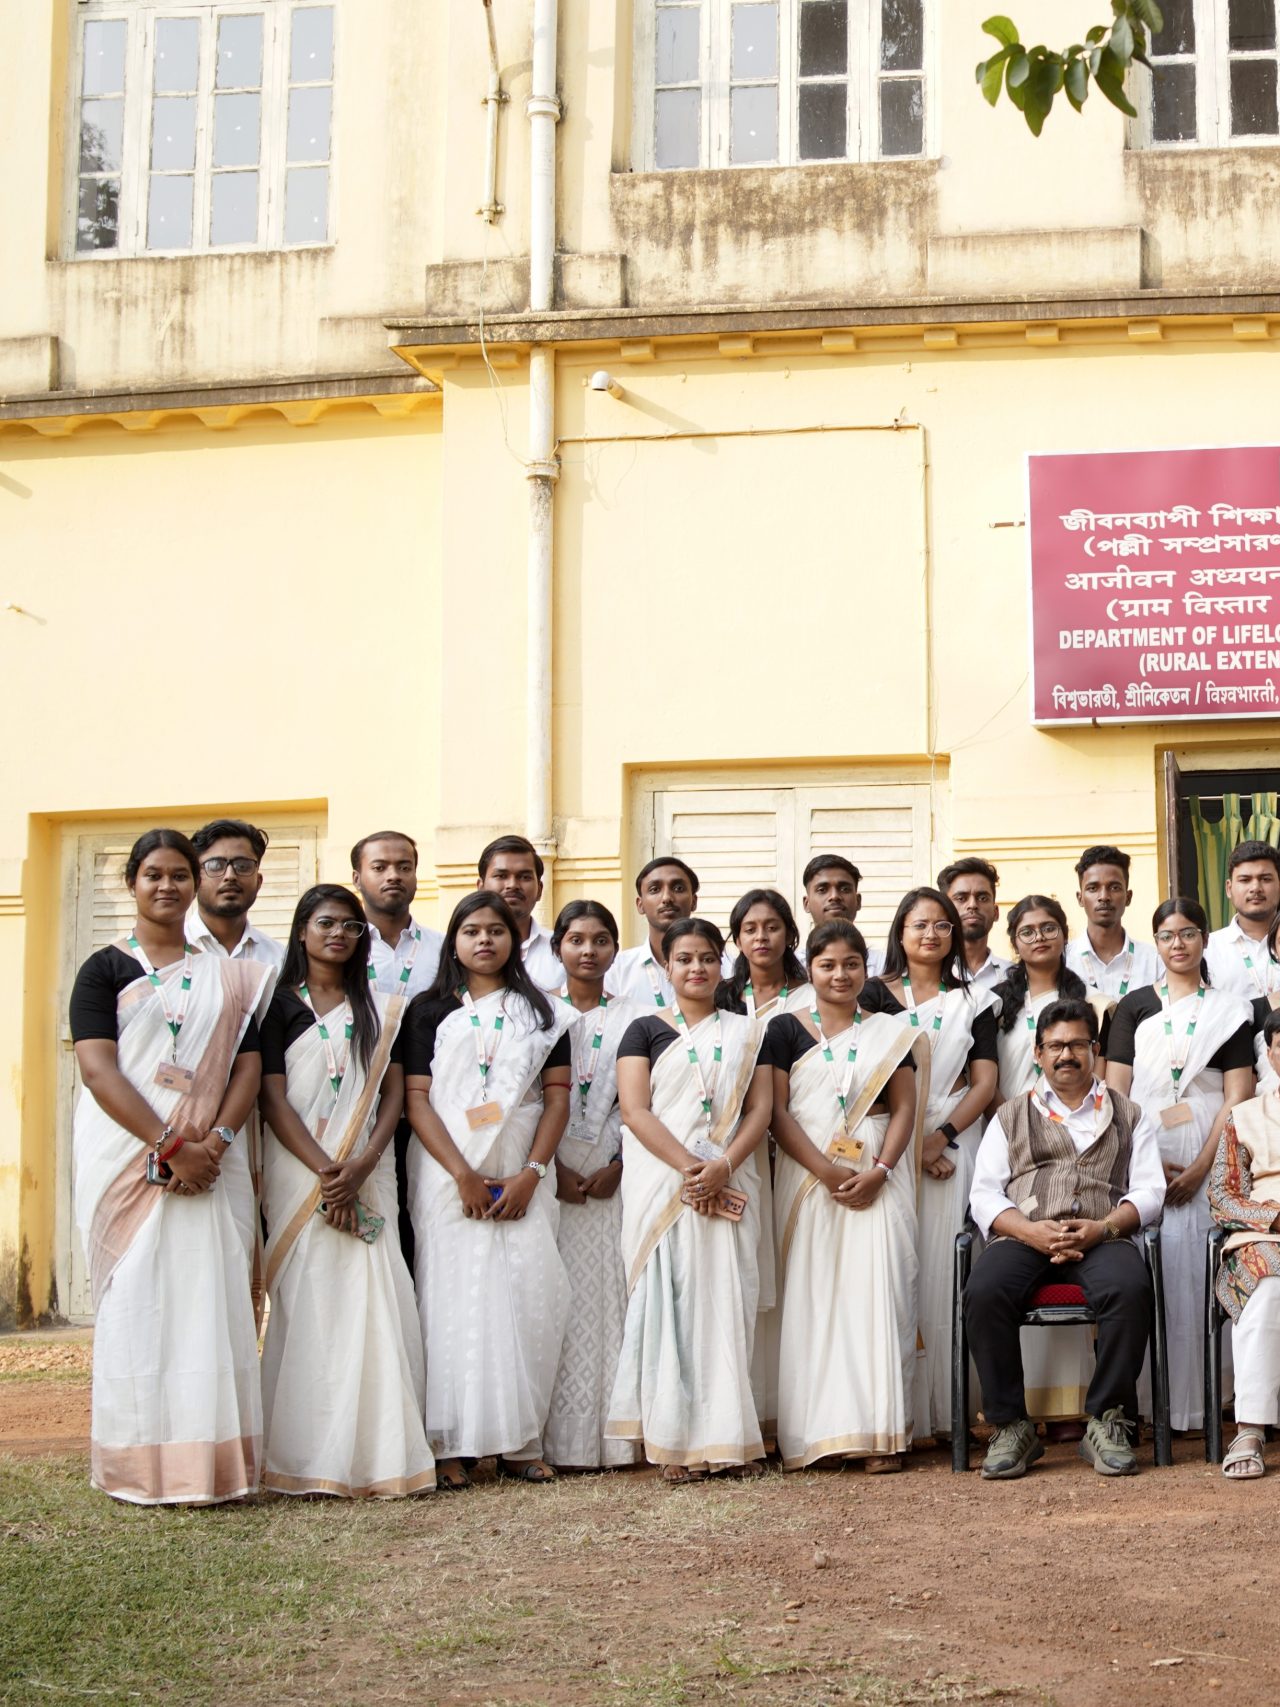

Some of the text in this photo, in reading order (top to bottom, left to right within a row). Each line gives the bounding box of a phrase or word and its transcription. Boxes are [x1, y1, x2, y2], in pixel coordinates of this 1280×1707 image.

[1058, 504, 1202, 532] জীবনব্যাপী
[1083, 533, 1154, 557] (পল্লী
[1064, 564, 1177, 591] आजीवन
[1106, 598, 1173, 622] (ग्राम
[1181, 591, 1273, 616] विस्तार
[1059, 626, 1187, 650] DEPARTMENT
[1191, 625, 1218, 646] OF
[1139, 651, 1212, 677] (RURAL
[1051, 683, 1121, 711] বিশ্বভারতী,
[1124, 681, 1191, 707] শ্রীনিকেতন
[1194, 681, 1201, 705] /
[1205, 678, 1280, 705] विश्वभारती,
